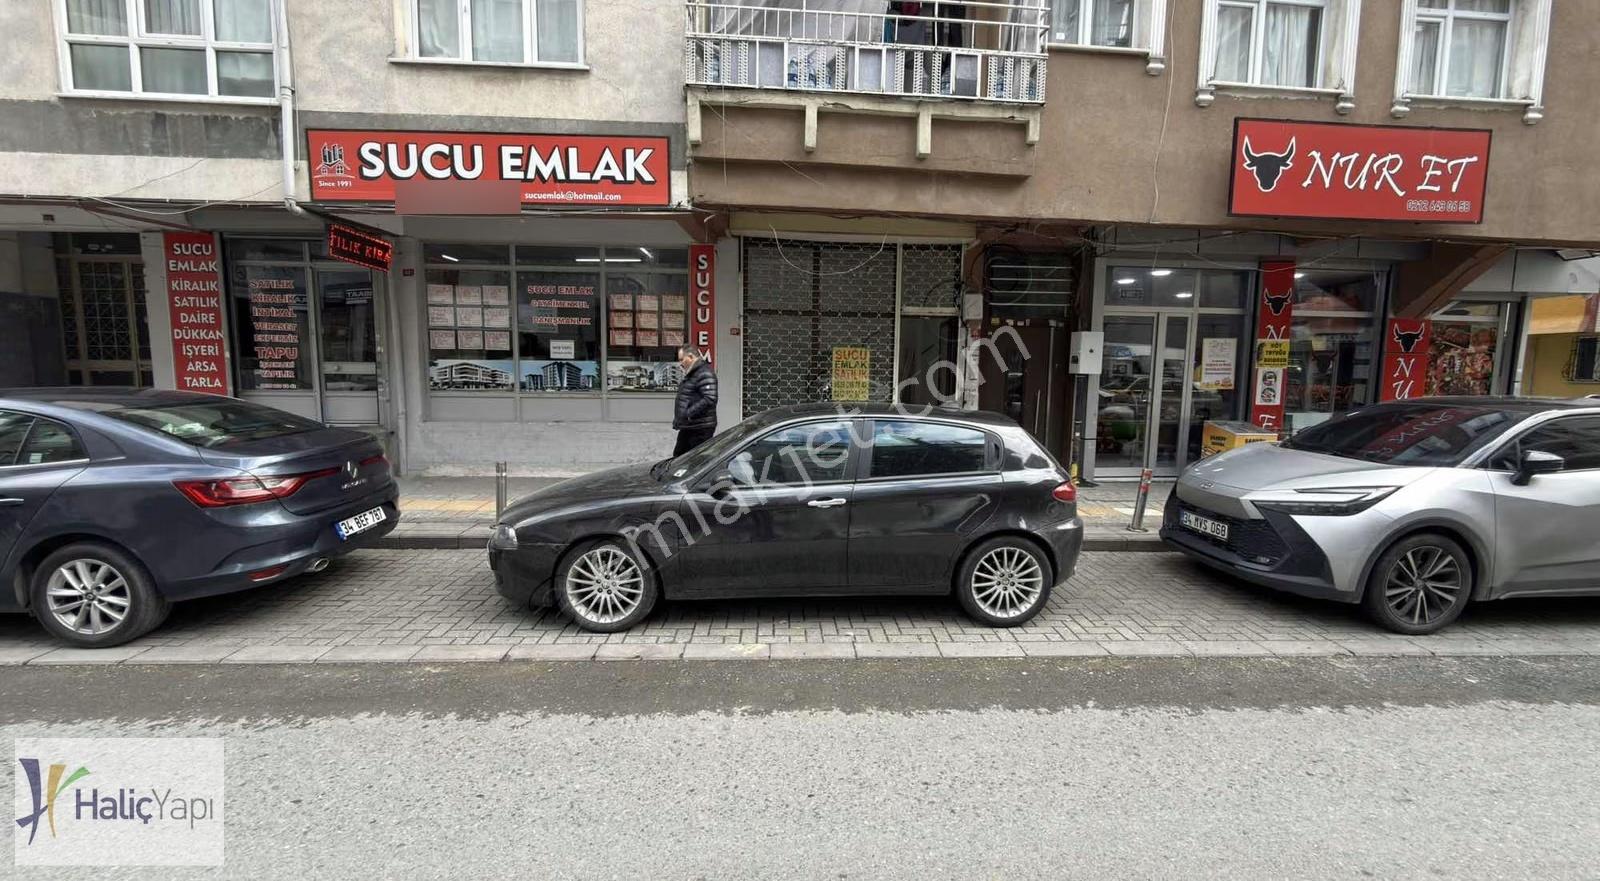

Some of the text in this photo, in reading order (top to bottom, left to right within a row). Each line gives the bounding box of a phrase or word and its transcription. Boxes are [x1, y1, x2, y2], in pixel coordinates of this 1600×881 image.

[359, 141, 656, 184] SUCU EMLAK
[1301, 150, 1479, 196] NUR ET
[525, 190, 622, 202] sucuemlak@hotmail.com
[1407, 199, 1429, 211] 0212
[173, 243, 212, 256] SUCU
[169, 260, 218, 272] EMLAK
[171, 277, 218, 291] KİRALIK
[248, 279, 295, 289] SATILIK
[527, 285, 594, 296] SUCU EMLAK
[697, 254, 710, 323] SUCU
[174, 296, 219, 308] SATILIK
[180, 311, 216, 324] DAİRE
[174, 326, 225, 340] DÜKKAN
[182, 343, 219, 358] İŞYERİ
[254, 346, 298, 360] TAPU
[835, 350, 868, 360] SUCU
[186, 361, 218, 372] ARSA
[835, 360, 868, 369] EMLAK
[184, 376, 223, 388] TARLA
[341, 522, 354, 534] 34
[354, 513, 369, 528] BEF
[1184, 511, 1192, 524] 34
